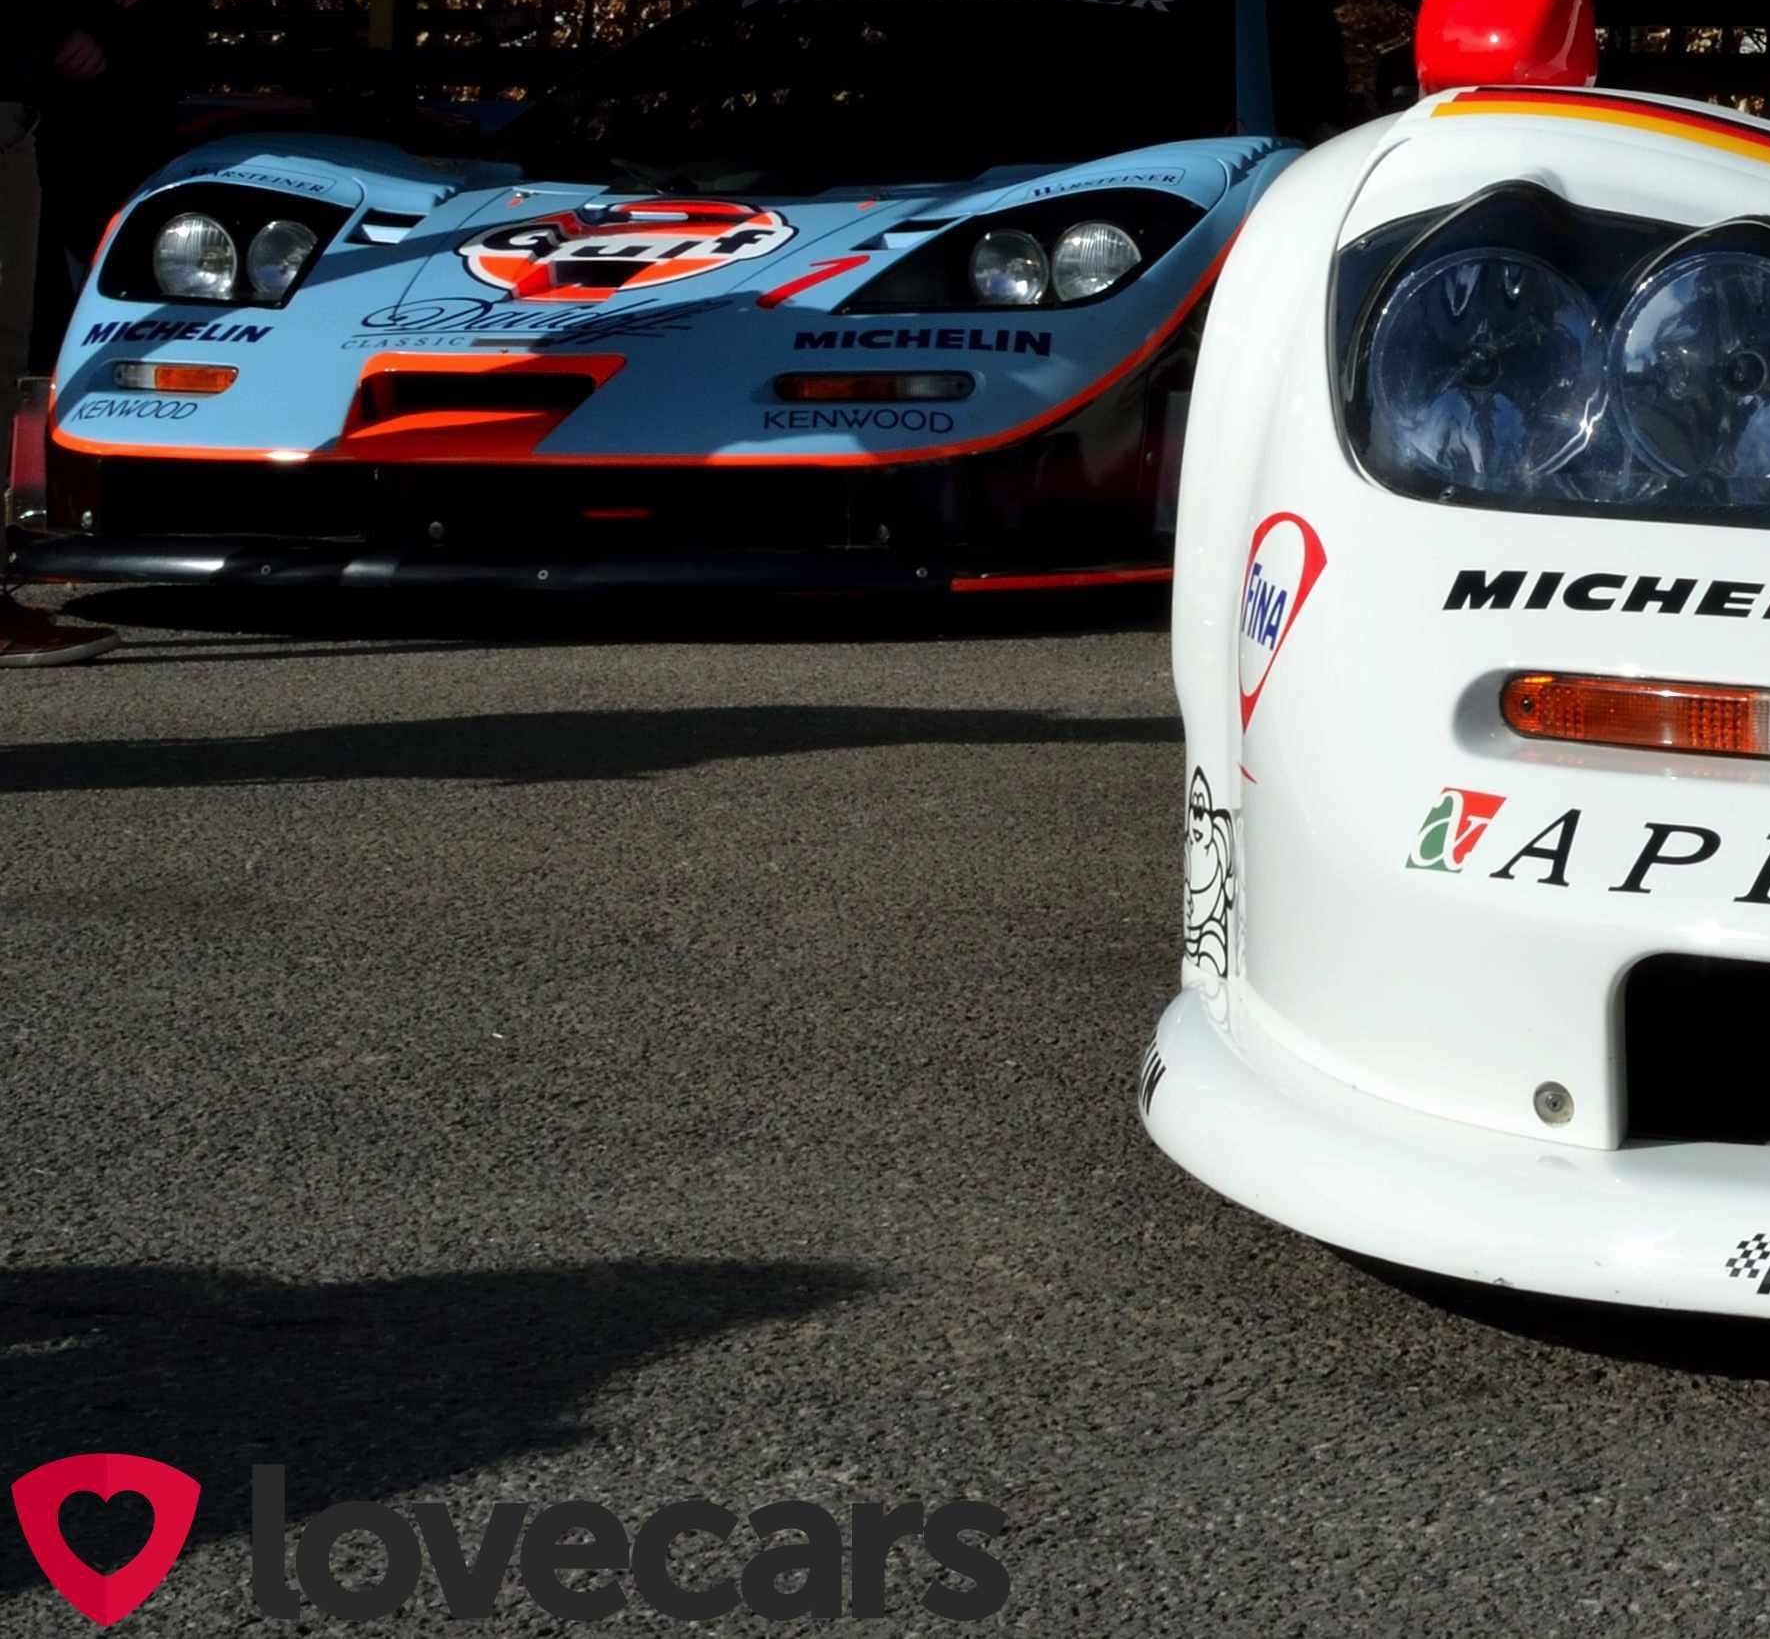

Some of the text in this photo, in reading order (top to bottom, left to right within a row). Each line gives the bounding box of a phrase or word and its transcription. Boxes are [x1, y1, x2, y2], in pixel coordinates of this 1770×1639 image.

[482, 223, 775, 260] Gulf
[81, 321, 274, 347] MICHELIN
[340, 336, 466, 350] CLASSIC
[793, 329, 1053, 356] MICHELIN
[71, 399, 198, 422] KENWOOD
[764, 409, 954, 434] KENWOOD
[1240, 561, 1288, 651] FINA
